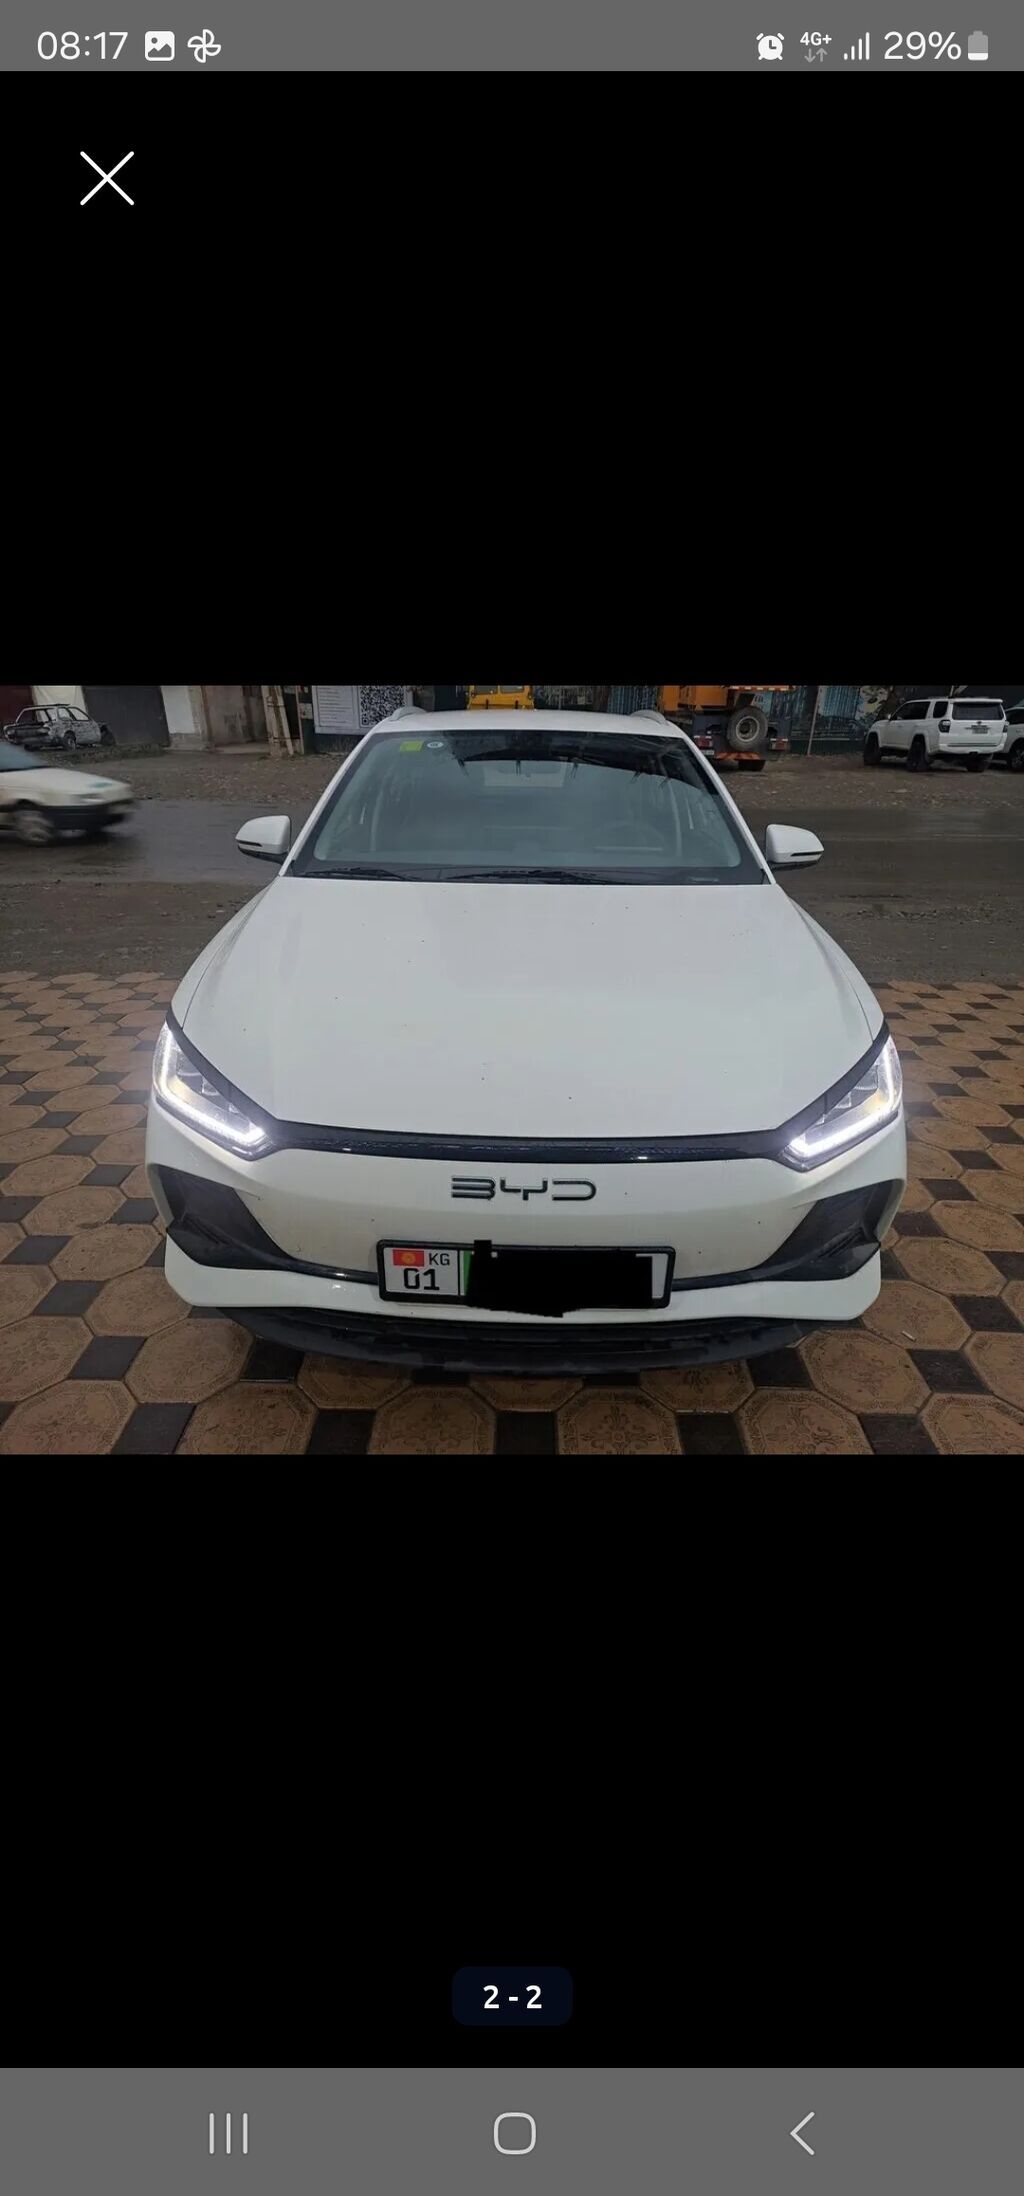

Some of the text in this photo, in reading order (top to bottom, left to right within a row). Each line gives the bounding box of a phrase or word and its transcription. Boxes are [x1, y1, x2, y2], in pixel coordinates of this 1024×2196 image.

[451, 1176, 597, 1201] BYD
[428, 1252, 451, 1266] KG
[403, 1268, 440, 1291] 01
